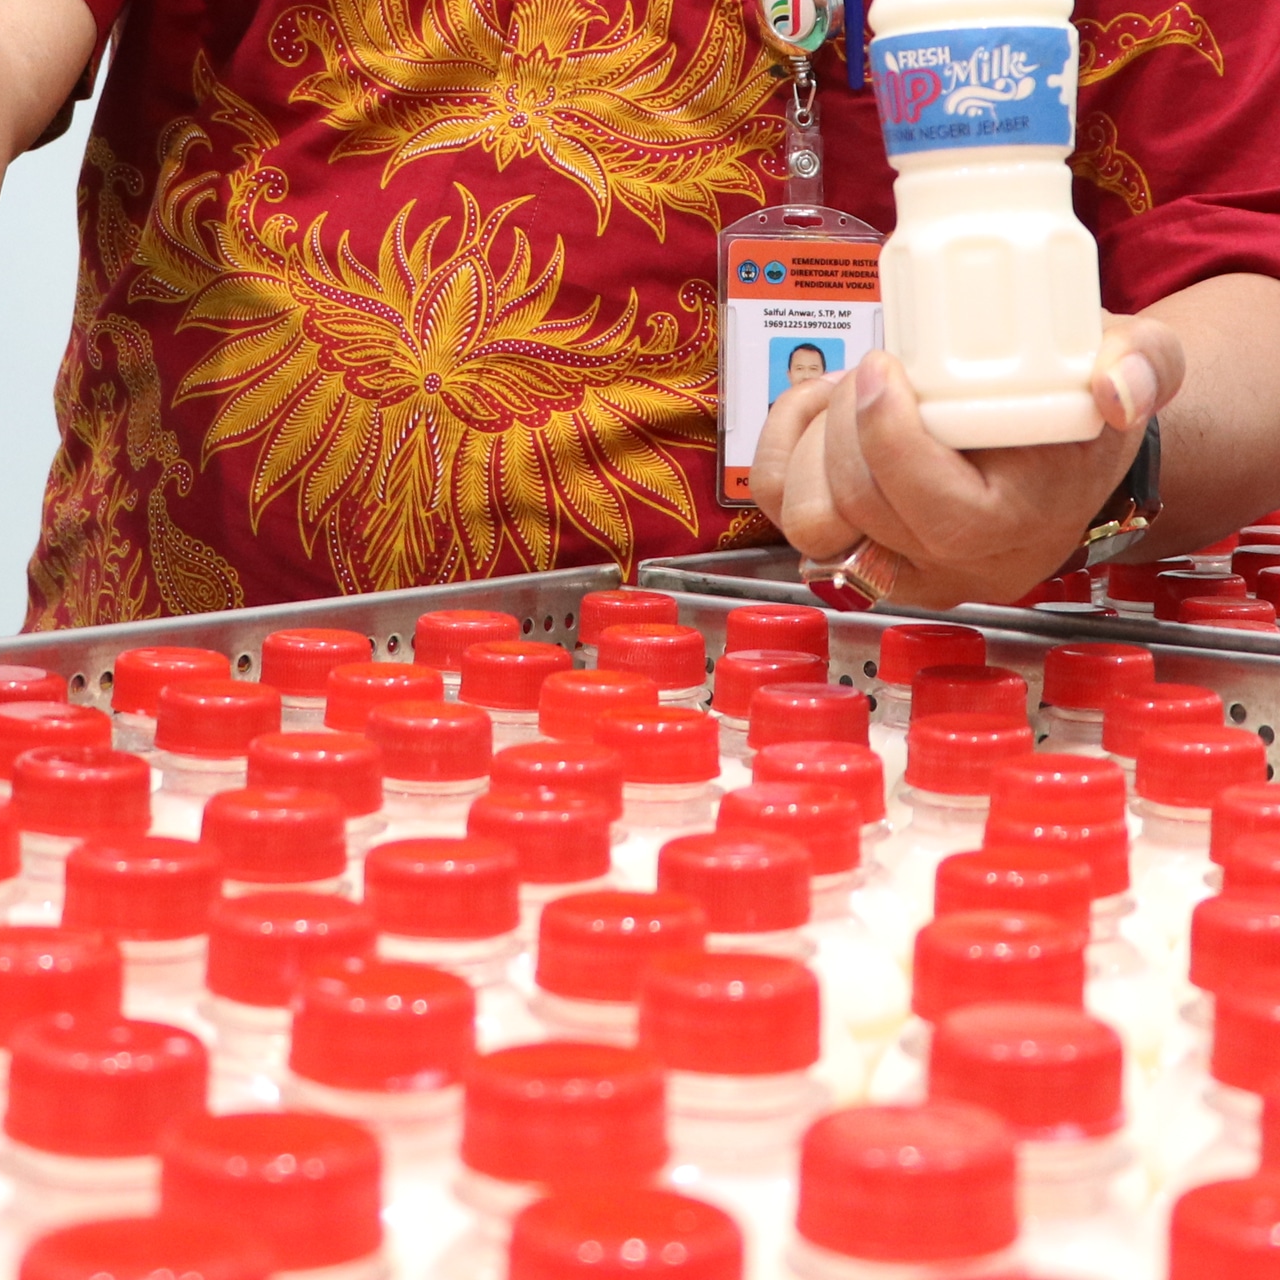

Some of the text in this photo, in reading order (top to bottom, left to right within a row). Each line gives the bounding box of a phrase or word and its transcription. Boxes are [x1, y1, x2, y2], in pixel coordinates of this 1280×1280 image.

[897, 46, 951, 69] FRESH
[942, 44, 1040, 95] Milk
[920, 122, 970, 140] NEGERI
[977, 116, 1030, 137] JEMBER
[791, 257, 878, 267] KEMENDIKBUD RISTEK
[790, 269, 879, 279] DIREKTORAT JENDERAL
[794, 280, 875, 290] PENDIDIKAN VOKASI
[788, 308, 817, 318] Anwar,
[838, 310, 852, 318] MP
[763, 320, 852, 330] 196912251997021005
